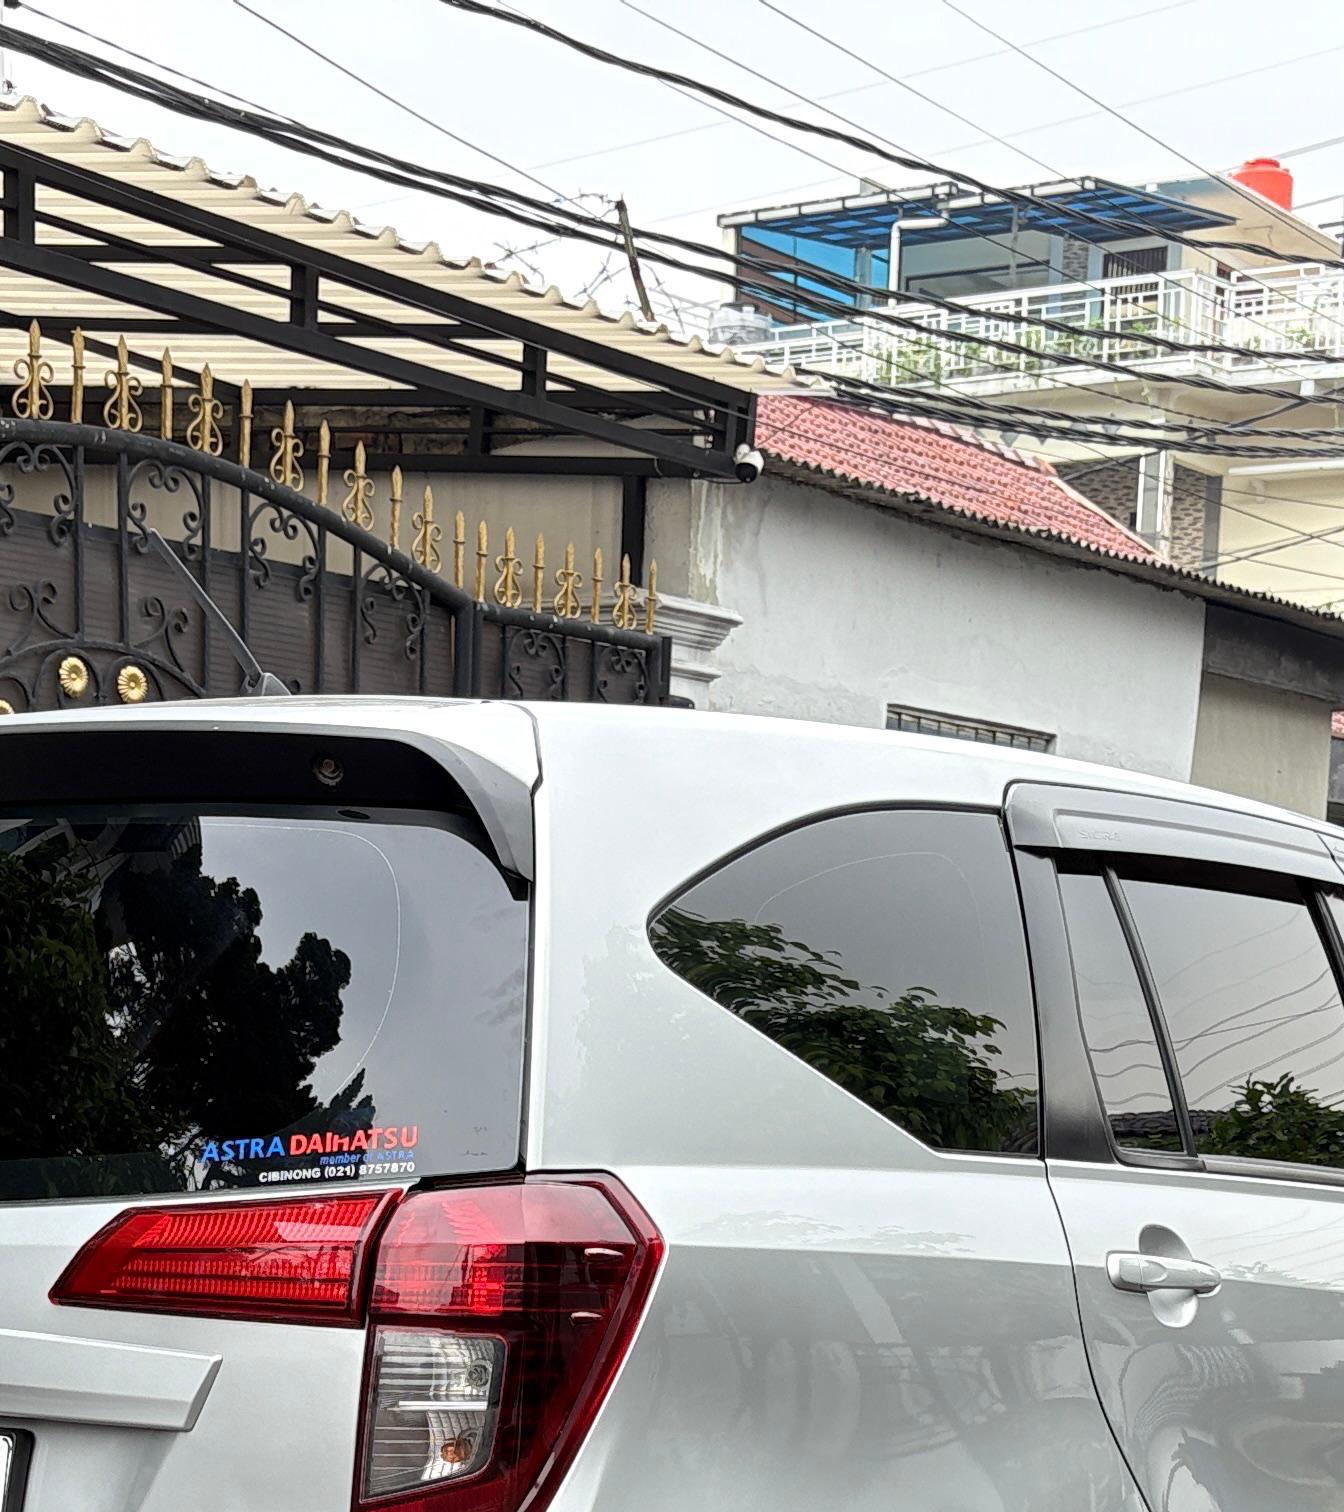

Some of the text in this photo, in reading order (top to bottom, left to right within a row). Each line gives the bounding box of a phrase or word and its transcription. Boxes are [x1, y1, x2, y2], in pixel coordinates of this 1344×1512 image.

[201, 1135, 286, 1164] ASTRA
[319, 1152, 361, 1166] member
[259, 1161, 416, 1183] CIBINONG (021) 8757870
